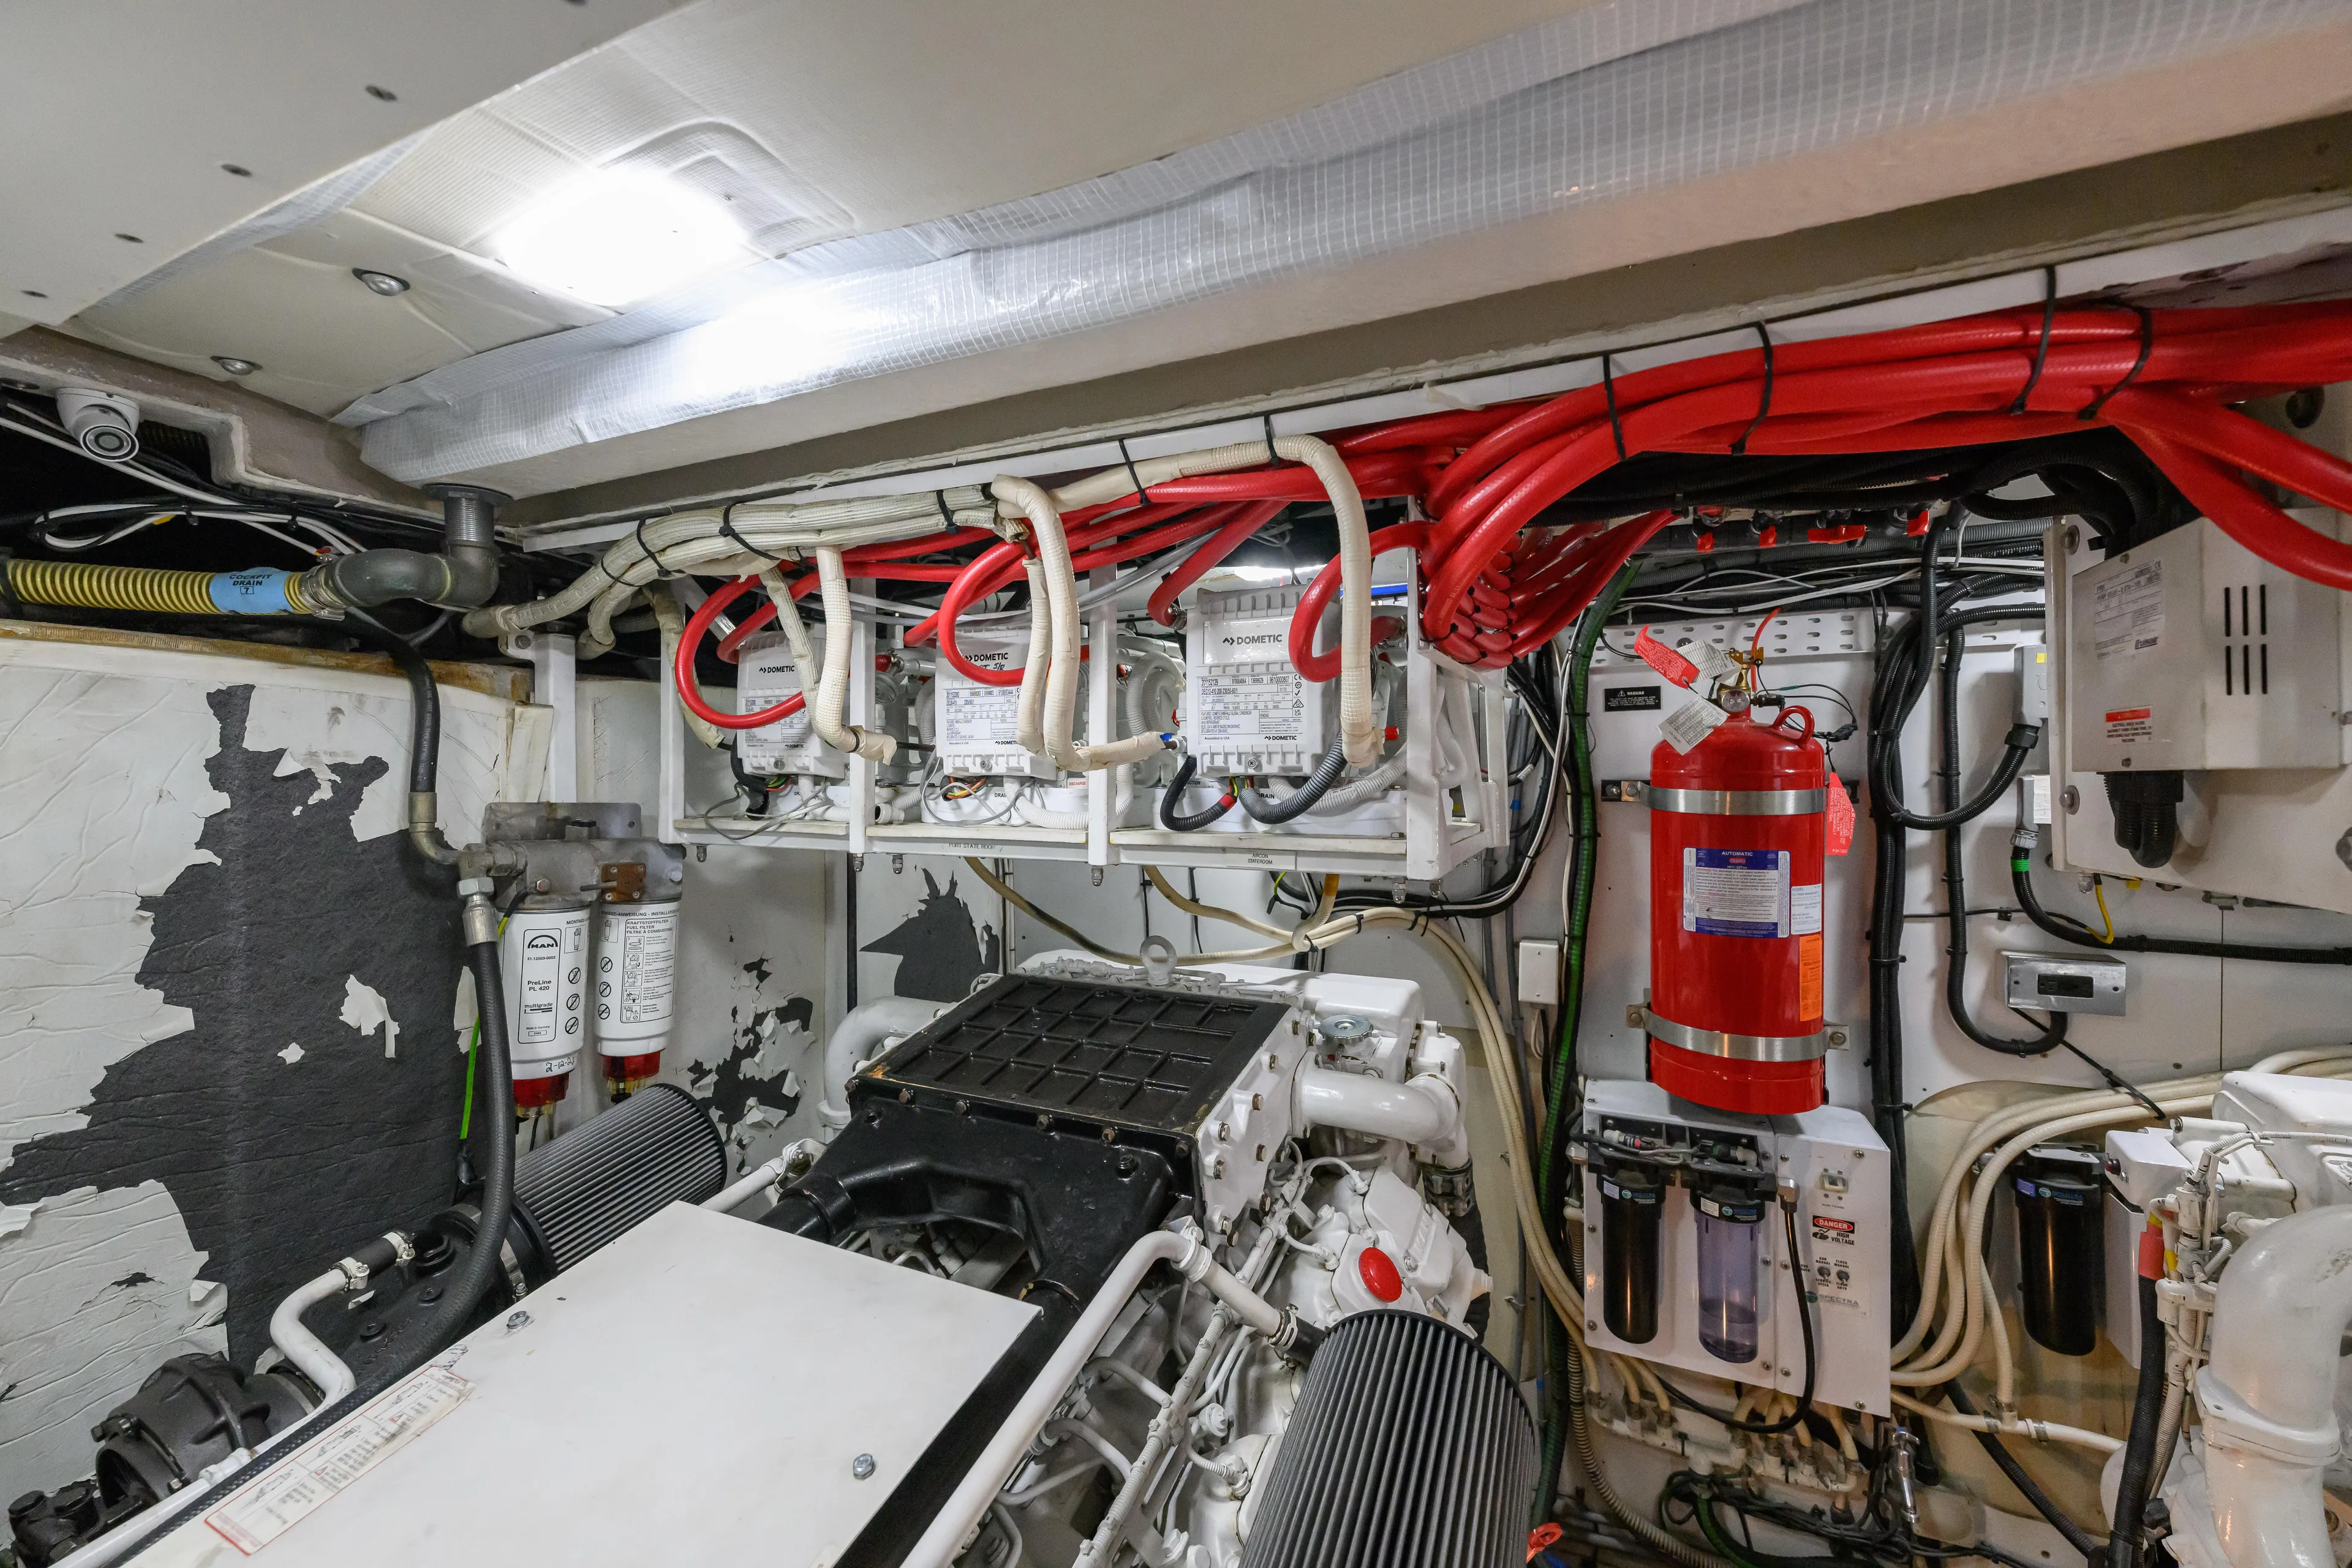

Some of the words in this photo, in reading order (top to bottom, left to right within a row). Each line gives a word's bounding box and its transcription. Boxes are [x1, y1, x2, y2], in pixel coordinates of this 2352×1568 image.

[1237, 634, 1283, 645] DOMETIC
[974, 652, 1009, 662] DOMETIC
[1638, 650, 1664, 674] WARNING
[1819, 1219, 1848, 1229] DANGER
[1831, 1236, 1855, 1245] VOLTAGE
[1819, 1294, 1860, 1306] SPECTRA
